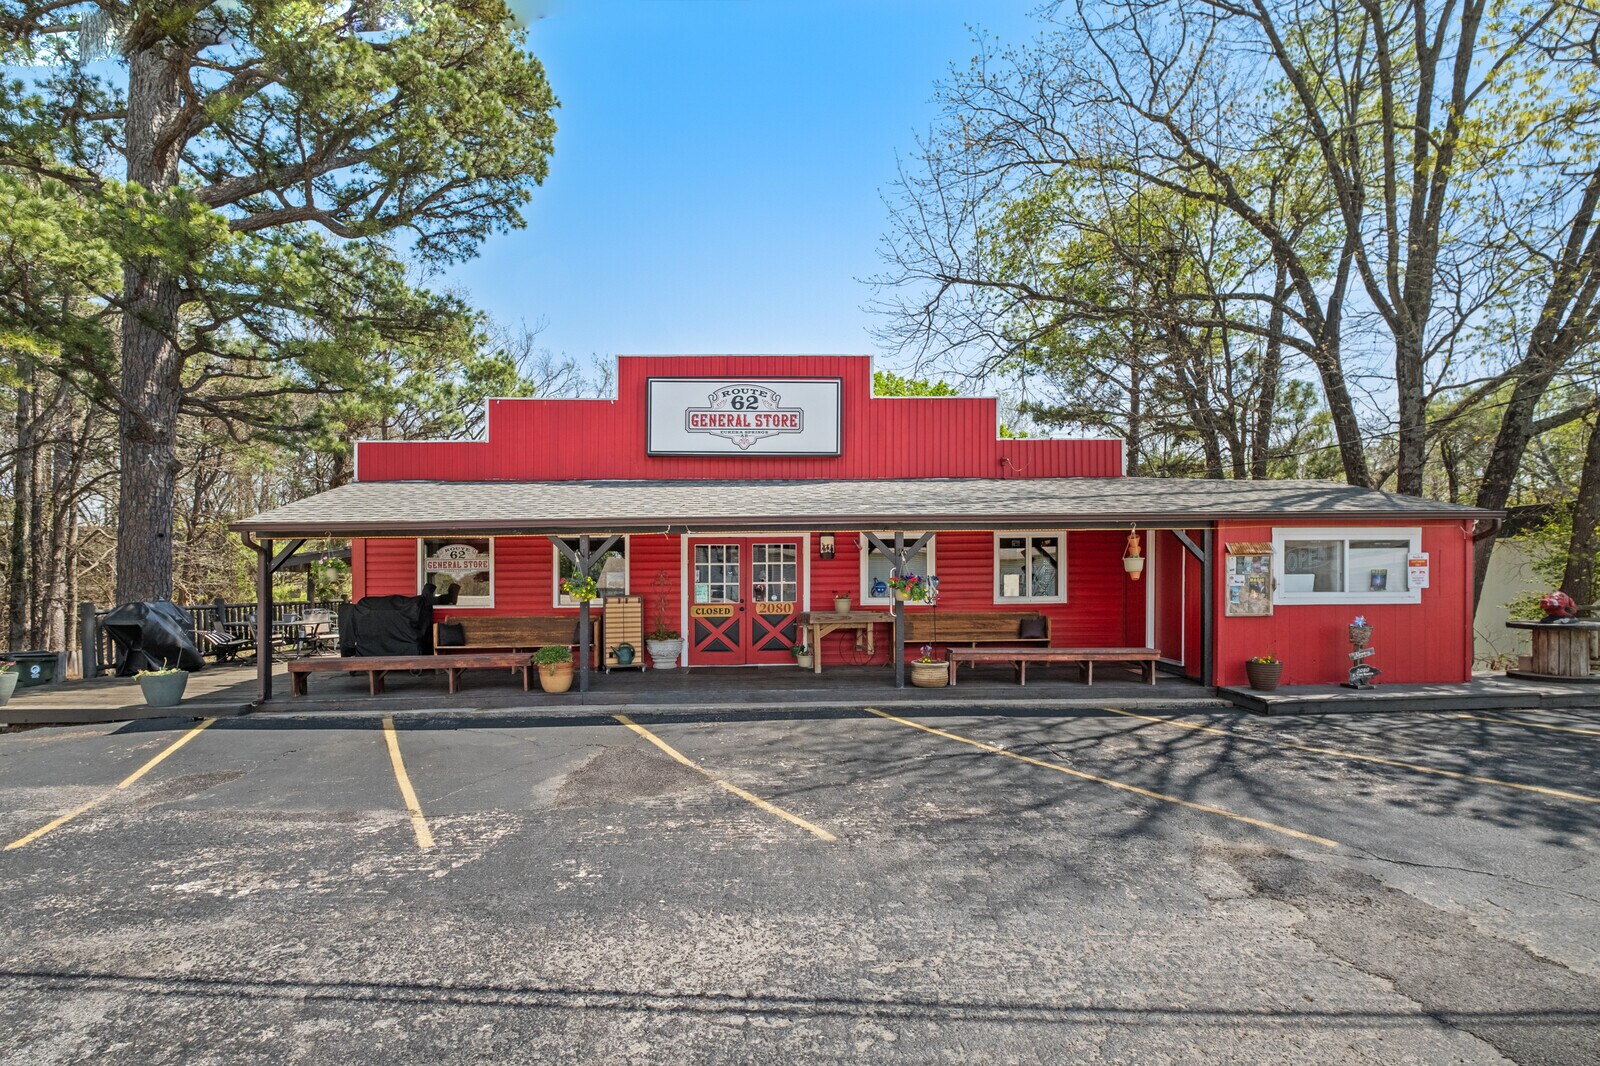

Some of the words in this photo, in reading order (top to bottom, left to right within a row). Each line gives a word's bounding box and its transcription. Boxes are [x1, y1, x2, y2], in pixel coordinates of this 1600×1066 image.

[721, 388, 768, 399] ROUTE
[730, 395, 759, 410] 62
[691, 413, 751, 428] GENERAL
[754, 413, 798, 428] STORE
[450, 550, 466, 559] 62
[427, 561, 462, 569] GENERAL
[464, 560, 488, 568] STORE
[695, 607, 731, 615] CLOSED
[759, 603, 791, 613] 2080
